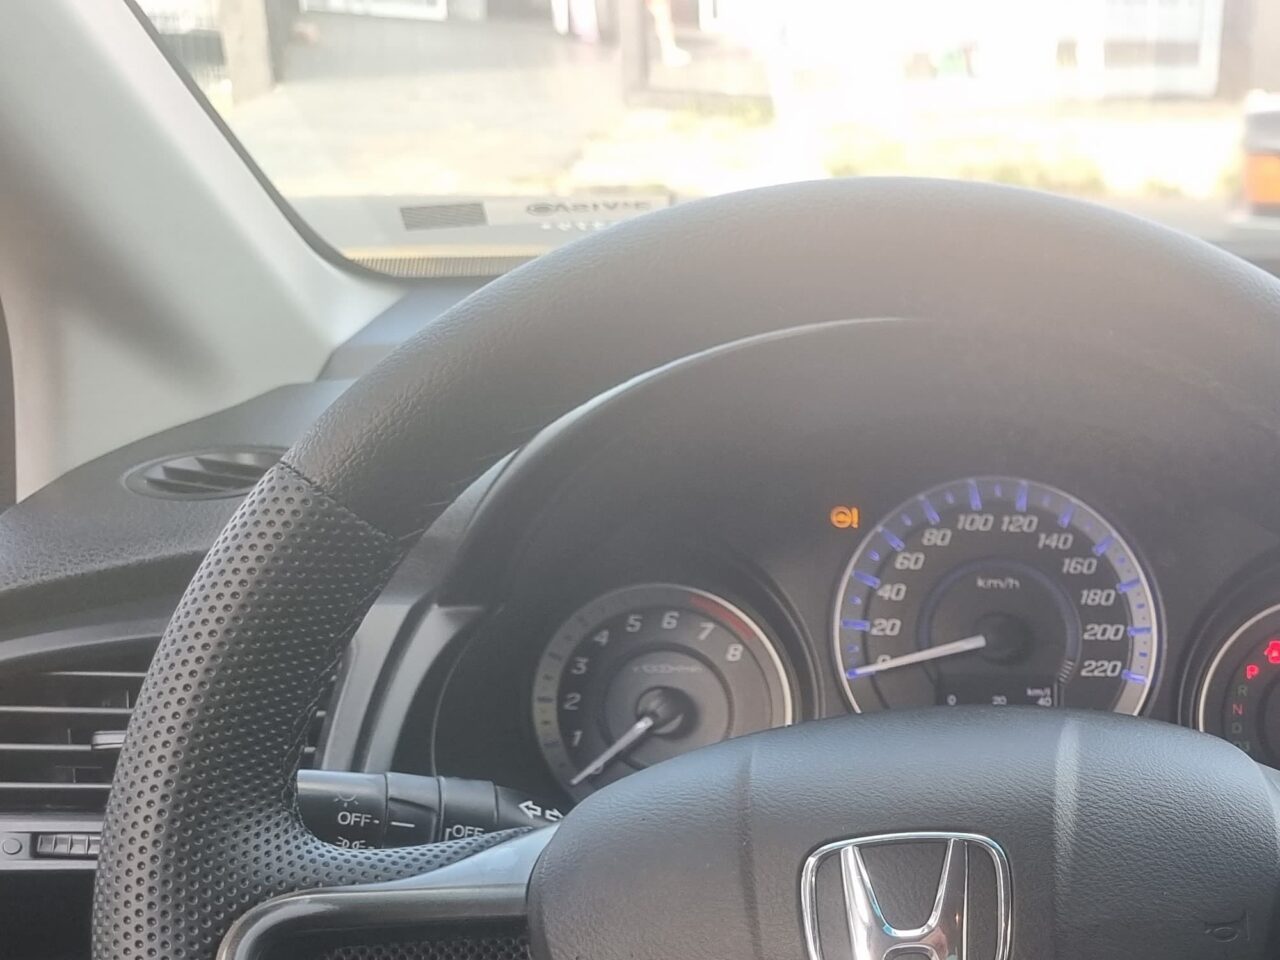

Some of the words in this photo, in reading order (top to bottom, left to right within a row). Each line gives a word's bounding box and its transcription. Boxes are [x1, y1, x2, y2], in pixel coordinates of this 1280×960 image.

[957, 514, 993, 531] 100
[1001, 515, 1038, 532] 120
[923, 529, 952, 546] 80
[1039, 532, 1073, 550] 140
[895, 552, 924, 570] 60
[1062, 557, 1097, 574] 160
[976, 576, 1020, 590] km/h
[877, 583, 906, 601] 40
[1081, 588, 1116, 606] 180
[626, 614, 643, 632] 5
[661, 611, 680, 629] 6
[871, 619, 901, 636] 20
[594, 630, 609, 646] 4
[699, 622, 715, 641] 7
[1083, 624, 1124, 641] 200
[725, 643, 743, 661] 8
[571, 657, 589, 674] 3
[1081, 660, 1121, 677] 220
[1246, 664, 1259, 679] P
[563, 693, 581, 710] 2
[1233, 704, 1243, 715] N
[572, 730, 582, 746] 1
[337, 811, 371, 826] OFF
